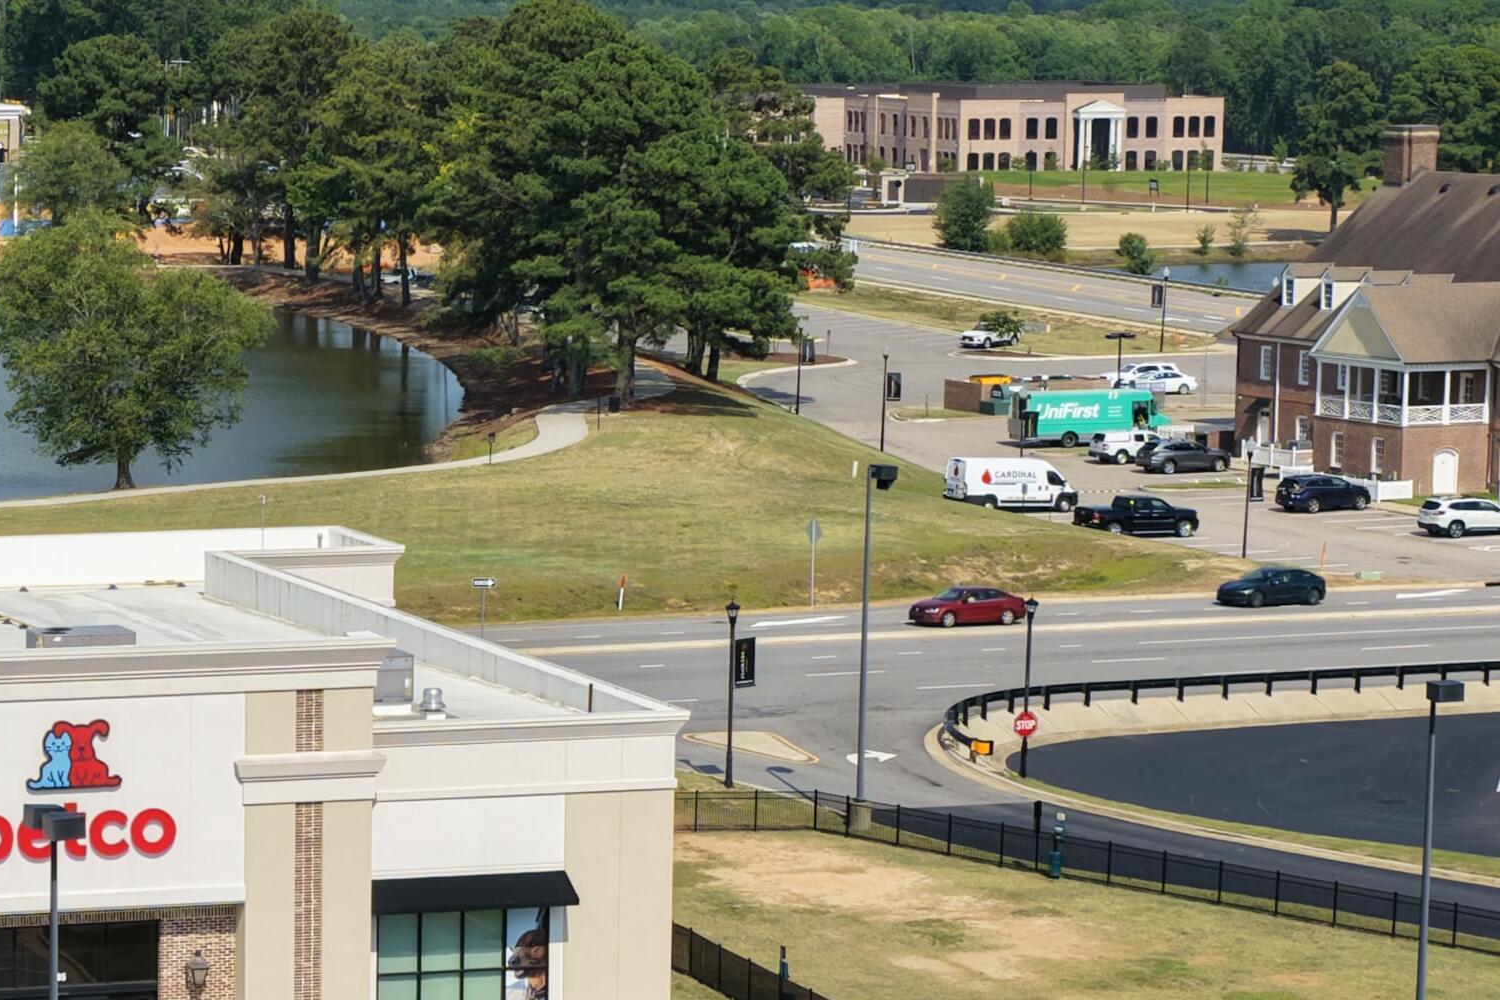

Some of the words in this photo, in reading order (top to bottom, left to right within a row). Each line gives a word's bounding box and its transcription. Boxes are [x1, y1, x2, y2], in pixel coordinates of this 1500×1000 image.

[1037, 402, 1100, 420] UniFirst
[995, 470, 1037, 479] CARDINAL
[1016, 719, 1036, 731] STOP
